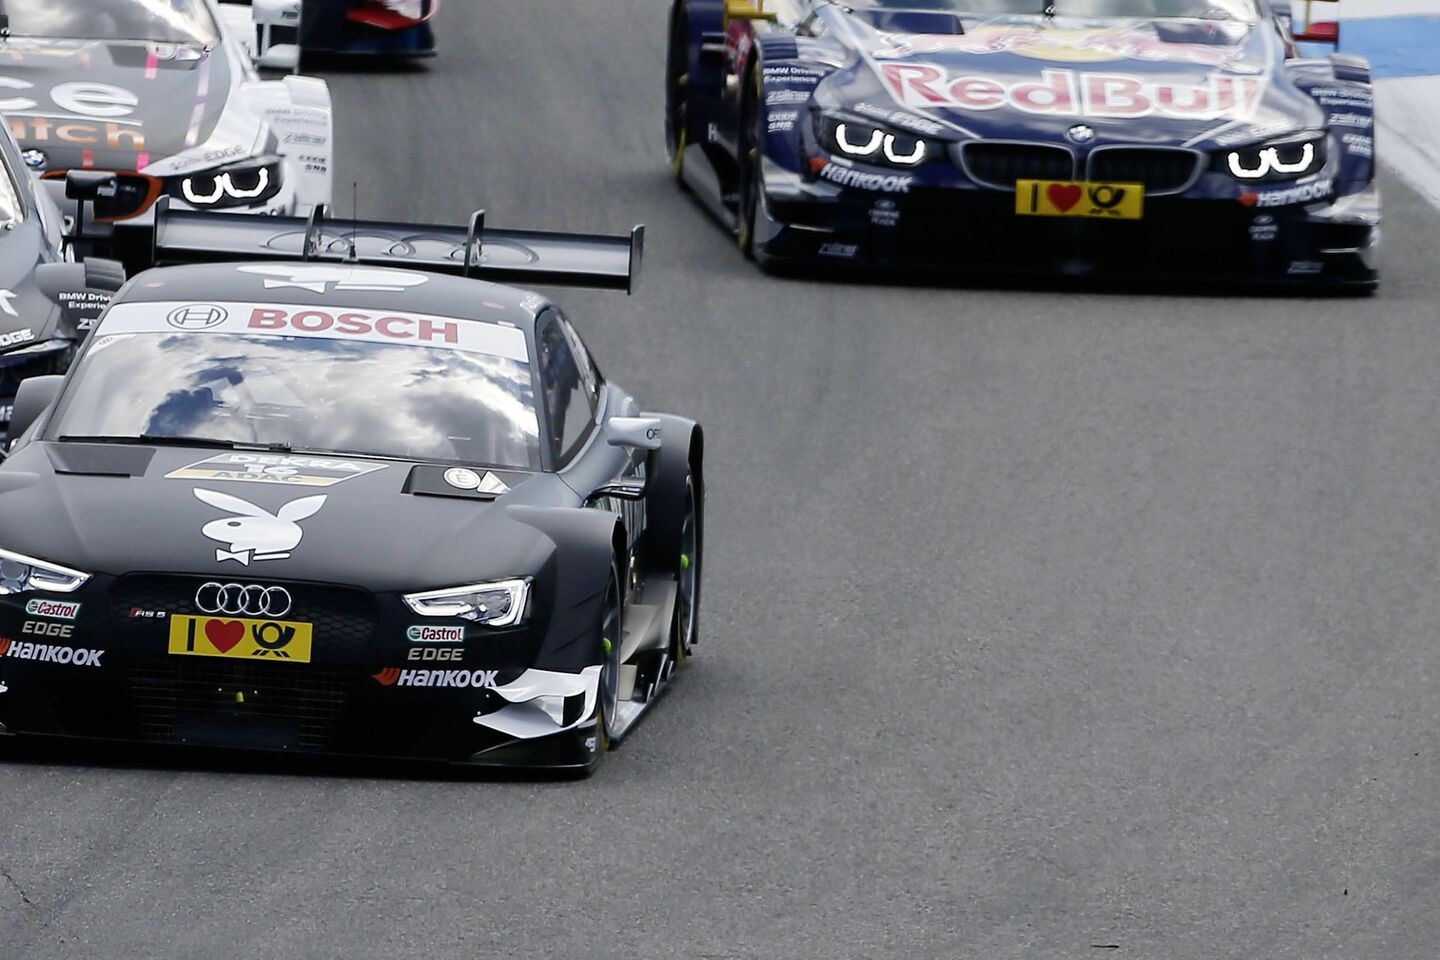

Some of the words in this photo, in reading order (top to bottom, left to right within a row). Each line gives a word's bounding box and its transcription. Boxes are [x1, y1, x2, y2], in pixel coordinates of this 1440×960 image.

[879, 63, 1077, 114] Red
[1083, 72, 1266, 118] Bull
[1031, 183, 1039, 212] I
[58, 292, 87, 301] BMW
[247, 308, 459, 344] BOSCH
[228, 454, 363, 471] DEKRA
[243, 463, 299, 476] 16
[210, 471, 304, 483] ADAC
[38, 601, 78, 618] Castrol
[21, 620, 75, 638] EDGE
[186, 618, 197, 652] I
[420, 626, 464, 642] Castrol
[407, 647, 464, 662] EDGE
